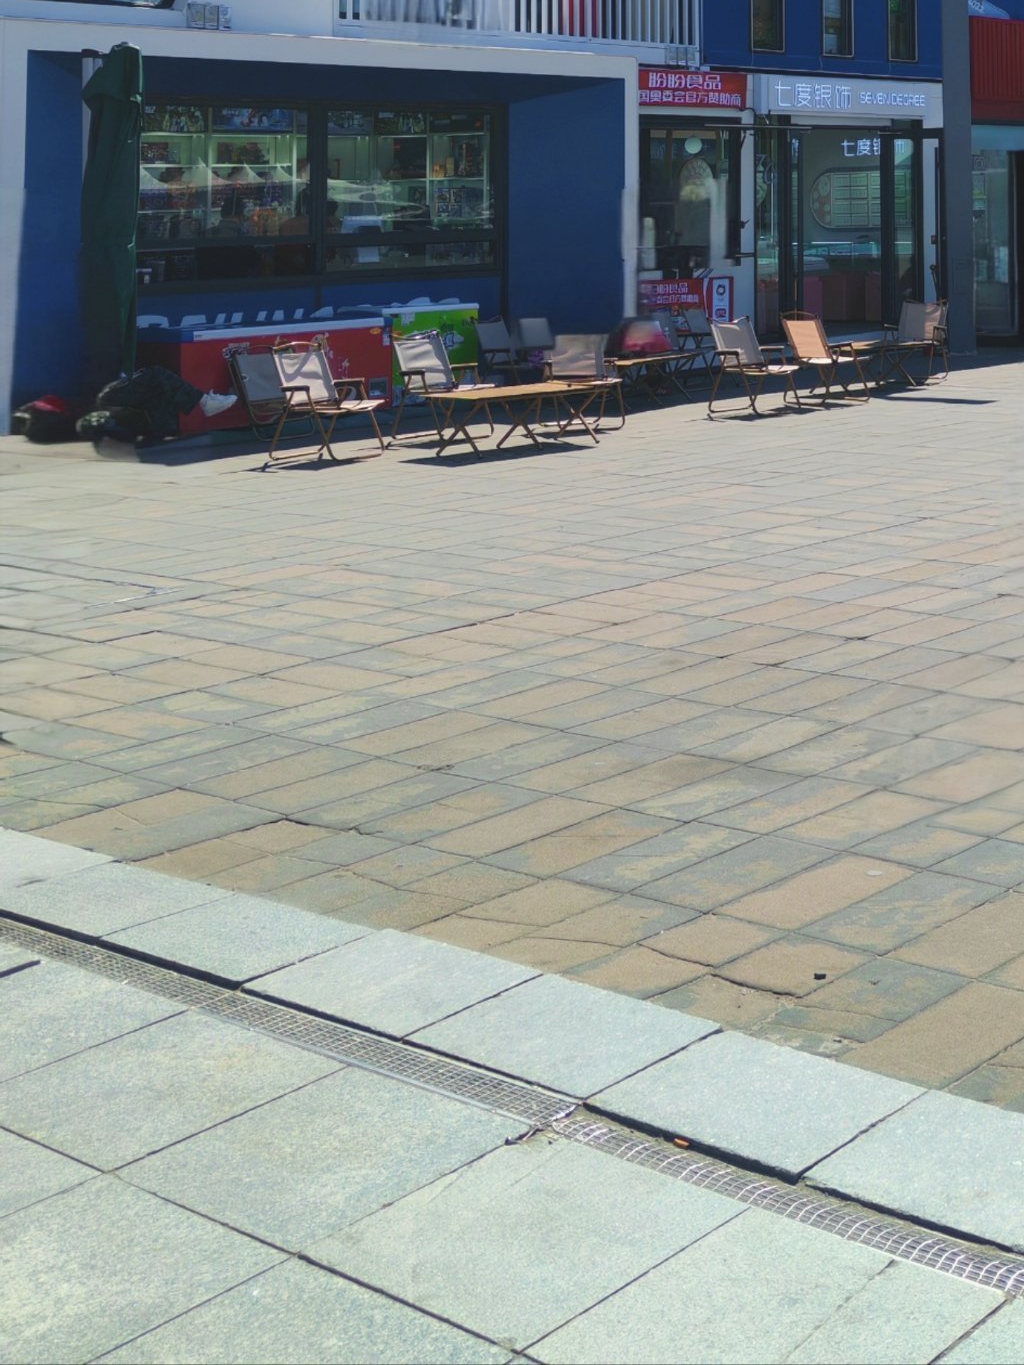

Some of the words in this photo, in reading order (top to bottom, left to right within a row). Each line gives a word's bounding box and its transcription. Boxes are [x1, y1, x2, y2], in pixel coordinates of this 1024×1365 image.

[649, 72, 721, 90] 盼盼食品
[639, 89, 741, 107] 国奥委会官方赞助商
[774, 80, 852, 109] 七度银饰
